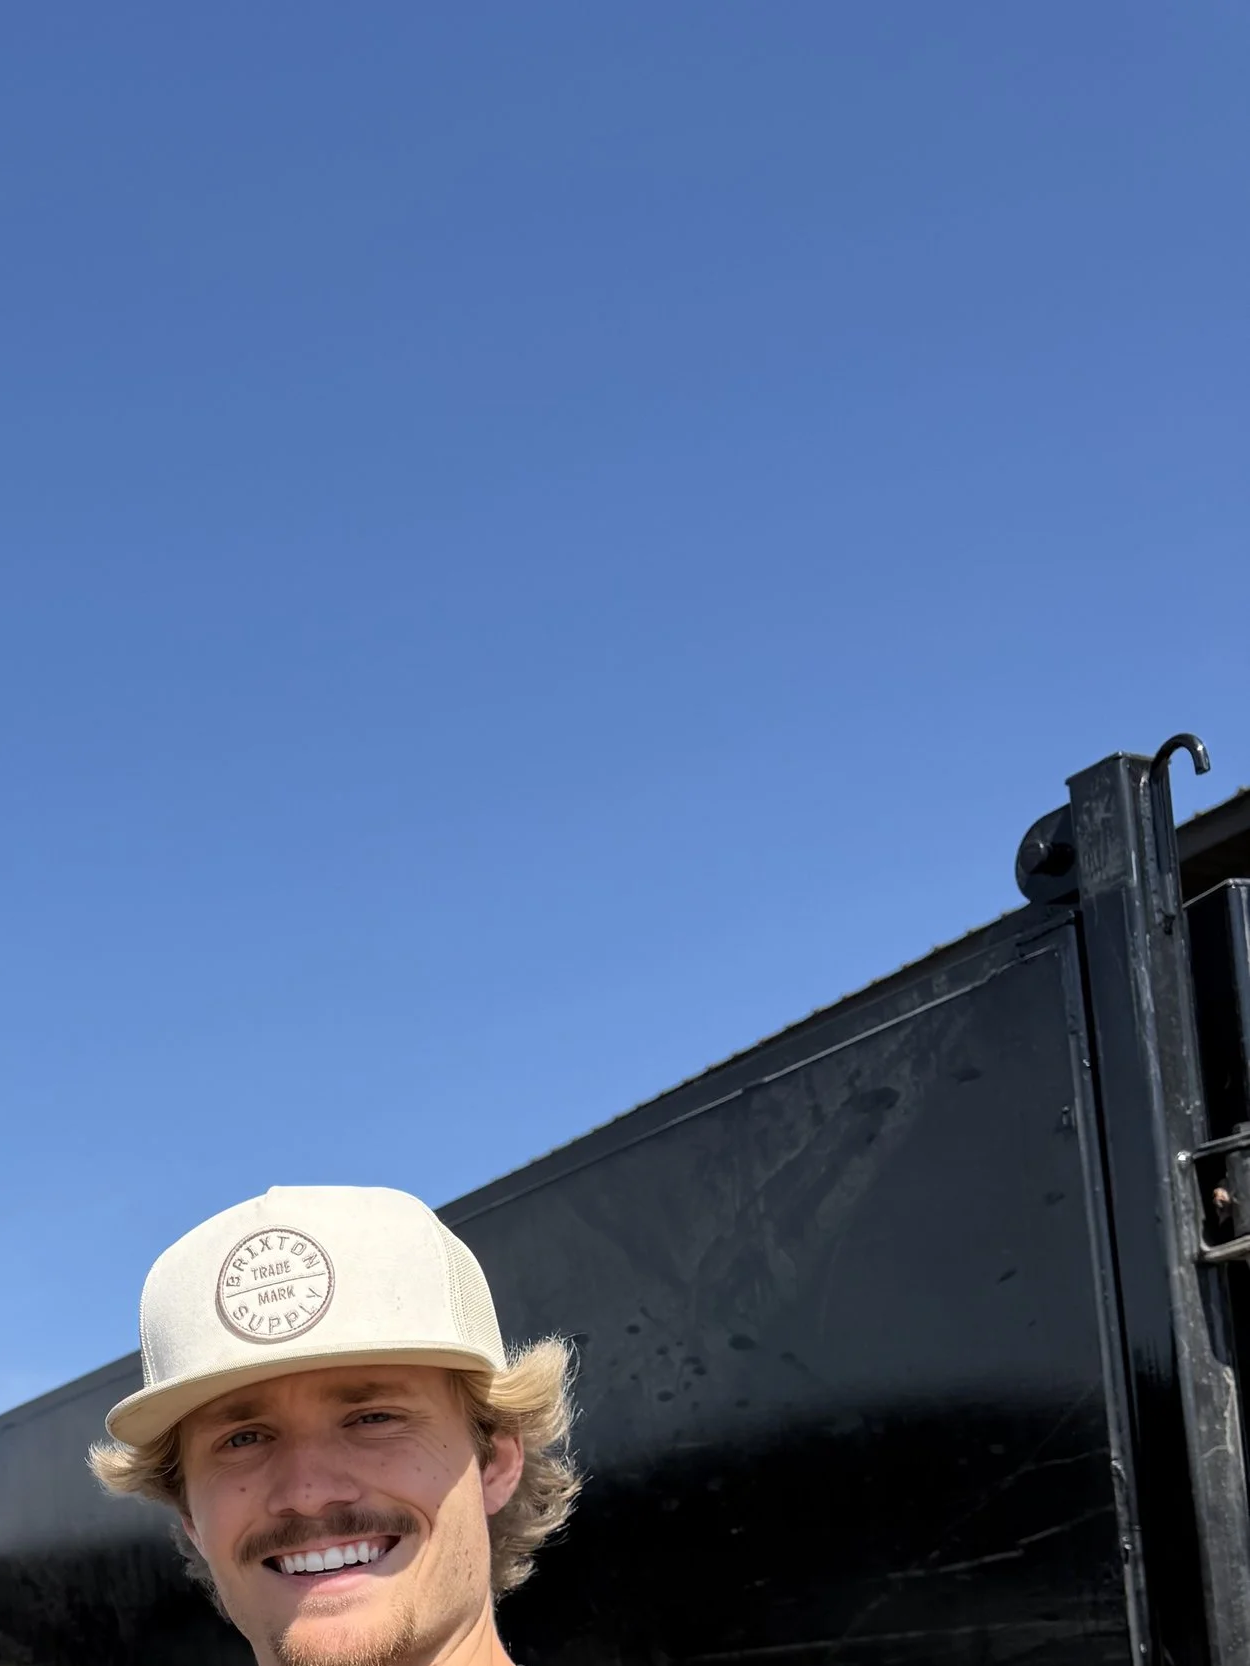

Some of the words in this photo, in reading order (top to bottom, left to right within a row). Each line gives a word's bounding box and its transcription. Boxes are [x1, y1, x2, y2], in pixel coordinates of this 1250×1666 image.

[226, 1236, 320, 1287] BRIXTON
[251, 1261, 291, 1280] TRADE
[232, 1288, 323, 1333] SUPPLY
[258, 1285, 296, 1306] MARK
